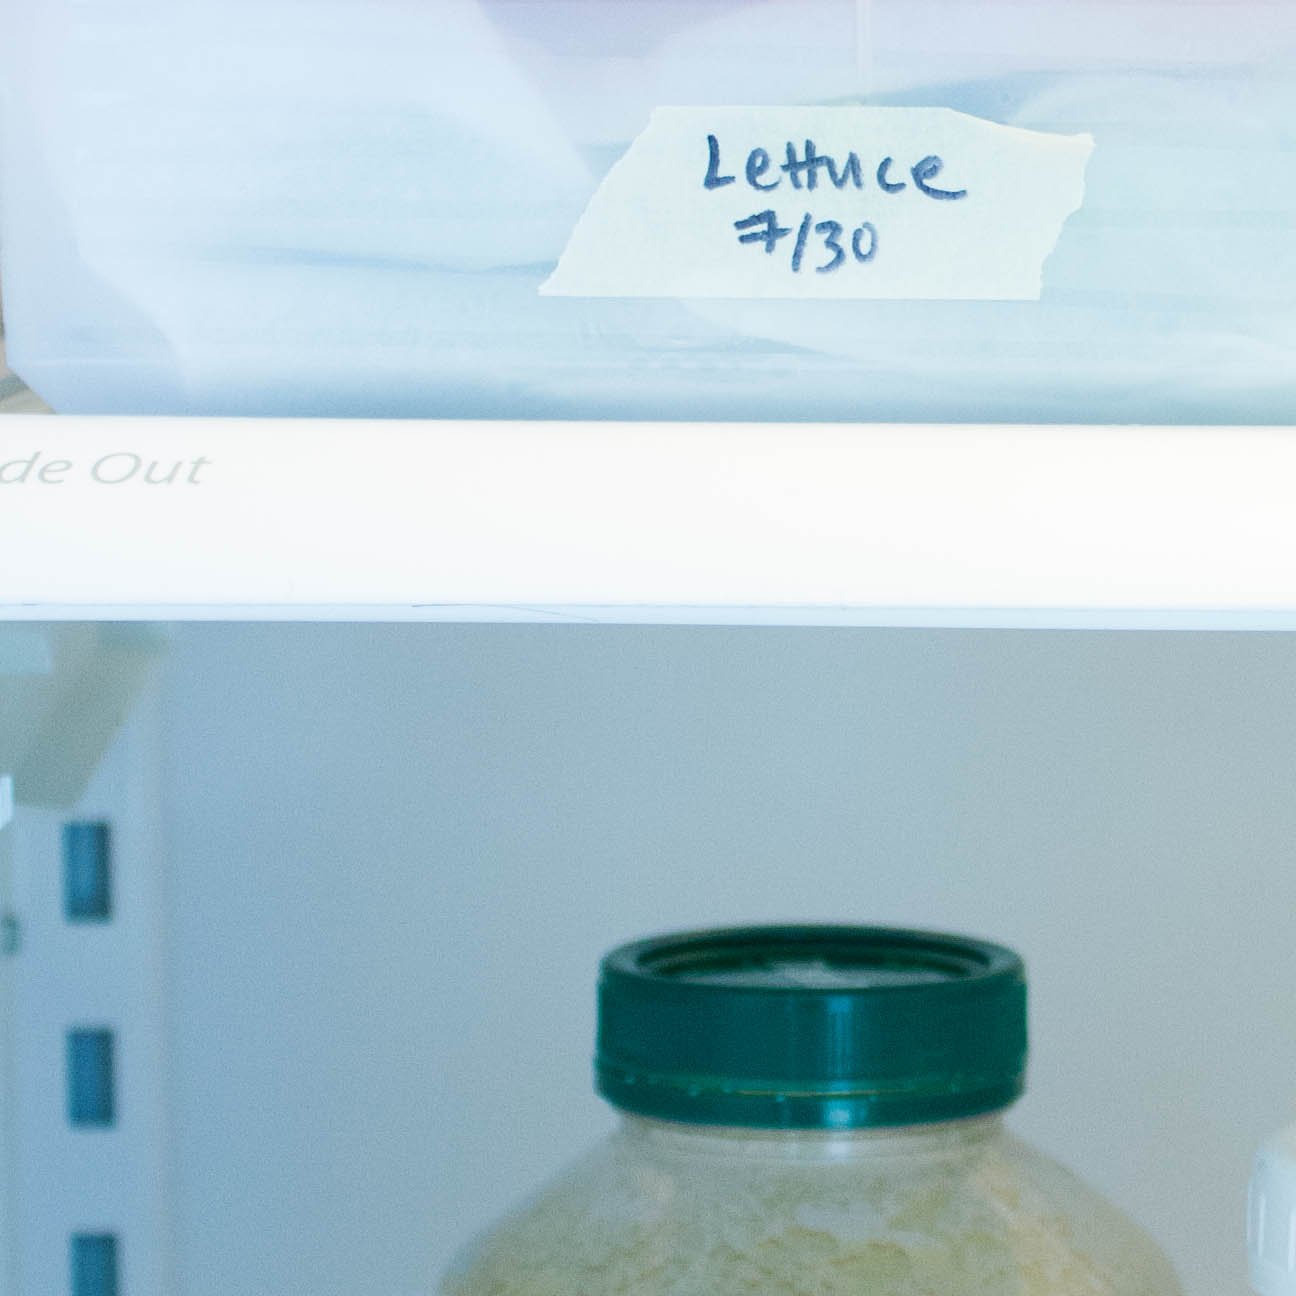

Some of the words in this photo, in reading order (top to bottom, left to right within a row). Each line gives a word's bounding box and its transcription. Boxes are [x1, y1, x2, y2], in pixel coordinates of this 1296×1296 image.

[702, 135, 967, 202] Lettuce
[732, 210, 879, 273] 7/30
[90, 452, 213, 485] Out
